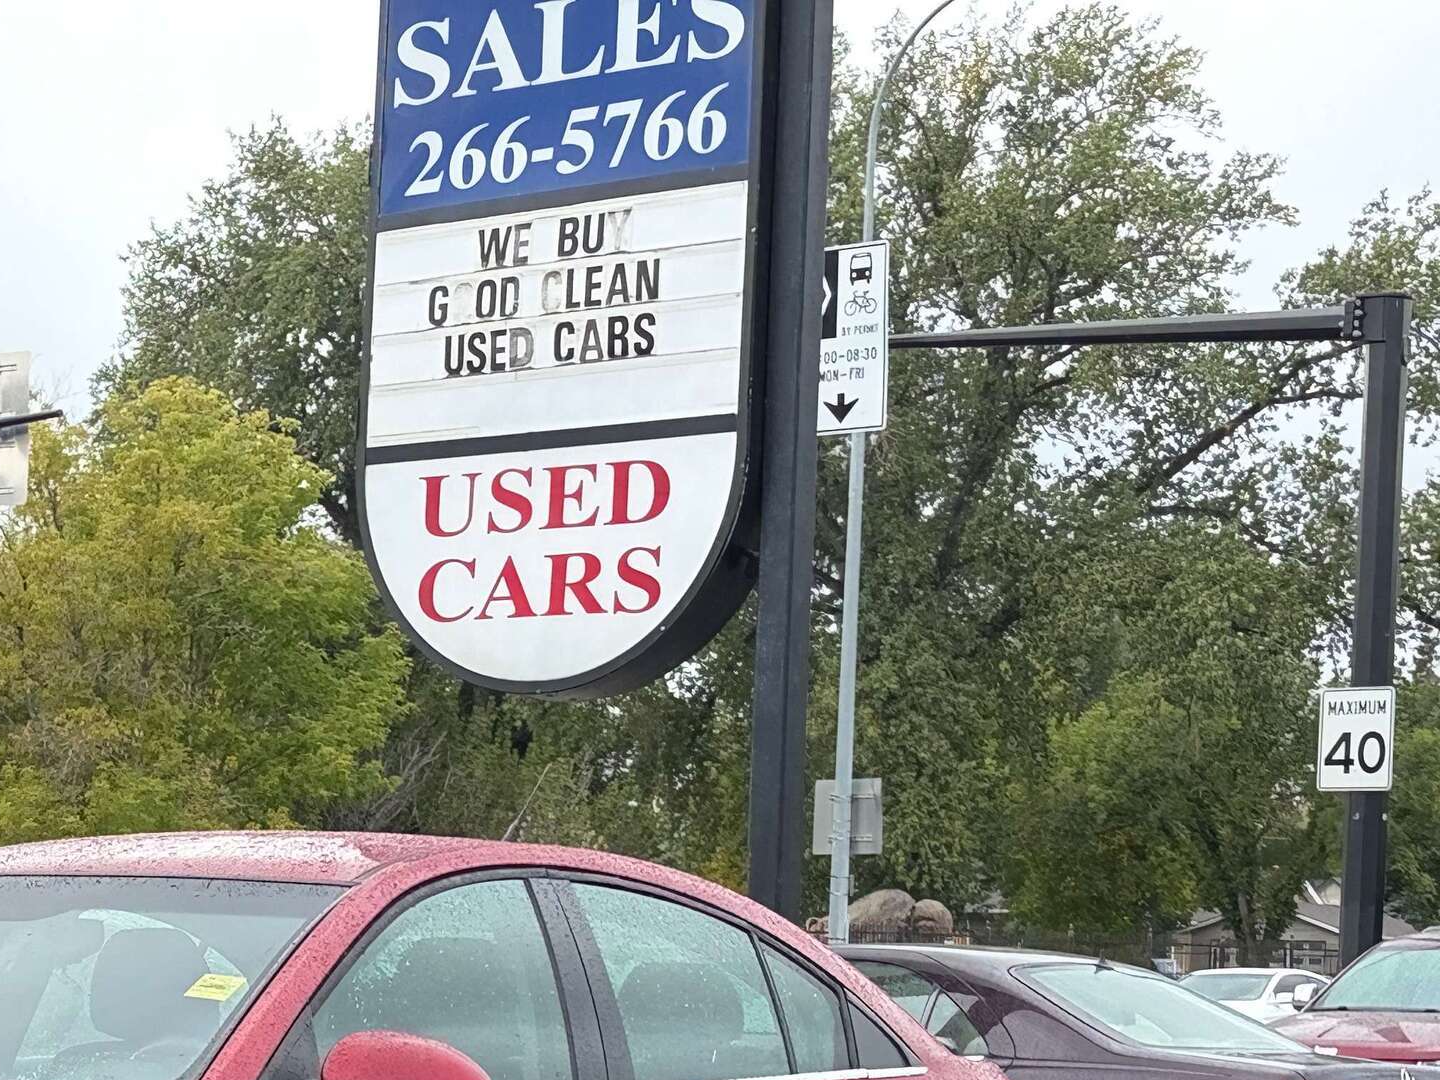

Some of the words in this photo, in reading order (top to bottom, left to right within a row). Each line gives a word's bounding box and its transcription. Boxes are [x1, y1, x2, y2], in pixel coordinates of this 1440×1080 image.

[394, 0, 746, 108] SALES
[404, 82, 730, 198] 266-5766
[478, 222, 533, 268] WE
[557, 207, 633, 257] BUY
[541, 258, 661, 315] CLEAN
[444, 327, 535, 376] USED
[553, 313, 657, 363] CARS
[418, 459, 671, 537] USED
[417, 546, 662, 623] CARS
[1327, 700, 1387, 716] MAXIMUM
[1324, 731, 1386, 774] 40
